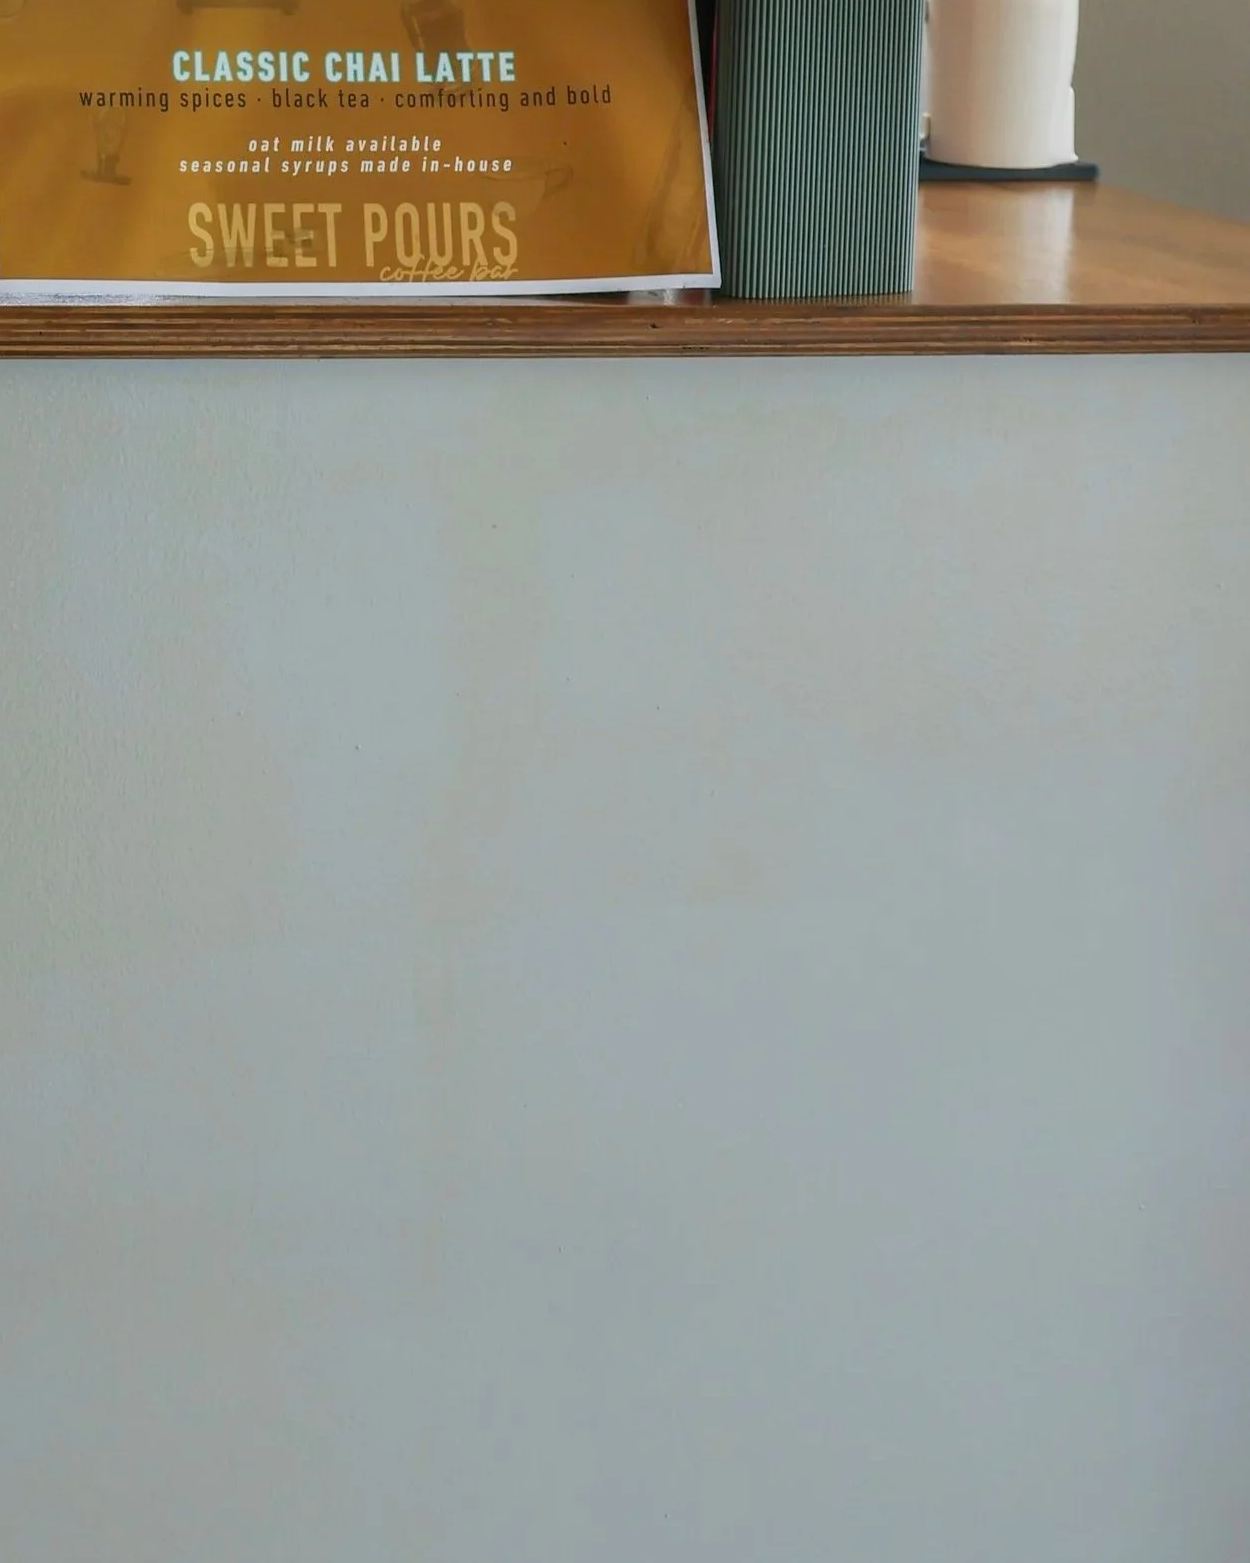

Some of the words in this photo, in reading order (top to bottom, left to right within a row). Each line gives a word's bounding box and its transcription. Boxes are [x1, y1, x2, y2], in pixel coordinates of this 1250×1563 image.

[172, 50, 310, 82] CLASSIC
[324, 51, 400, 82] CHAI
[415, 51, 516, 82] LATTE
[79, 87, 169, 112] warming
[179, 88, 247, 112] spices
[272, 88, 328, 108] black
[338, 89, 369, 108] tea
[395, 88, 509, 112] comforting
[520, 87, 556, 106] and
[567, 84, 612, 104] bold
[248, 137, 279, 152] oat
[291, 135, 335, 152] milk
[345, 135, 442, 152] available
[179, 157, 270, 173] seasonal
[281, 159, 349, 176] syrups
[360, 157, 411, 172] made
[422, 156, 513, 172] in-house
[188, 202, 342, 268] SWEET
[362, 201, 518, 268] POURS
[380, 255, 463, 283] coffee
[469, 258, 519, 281] bar
